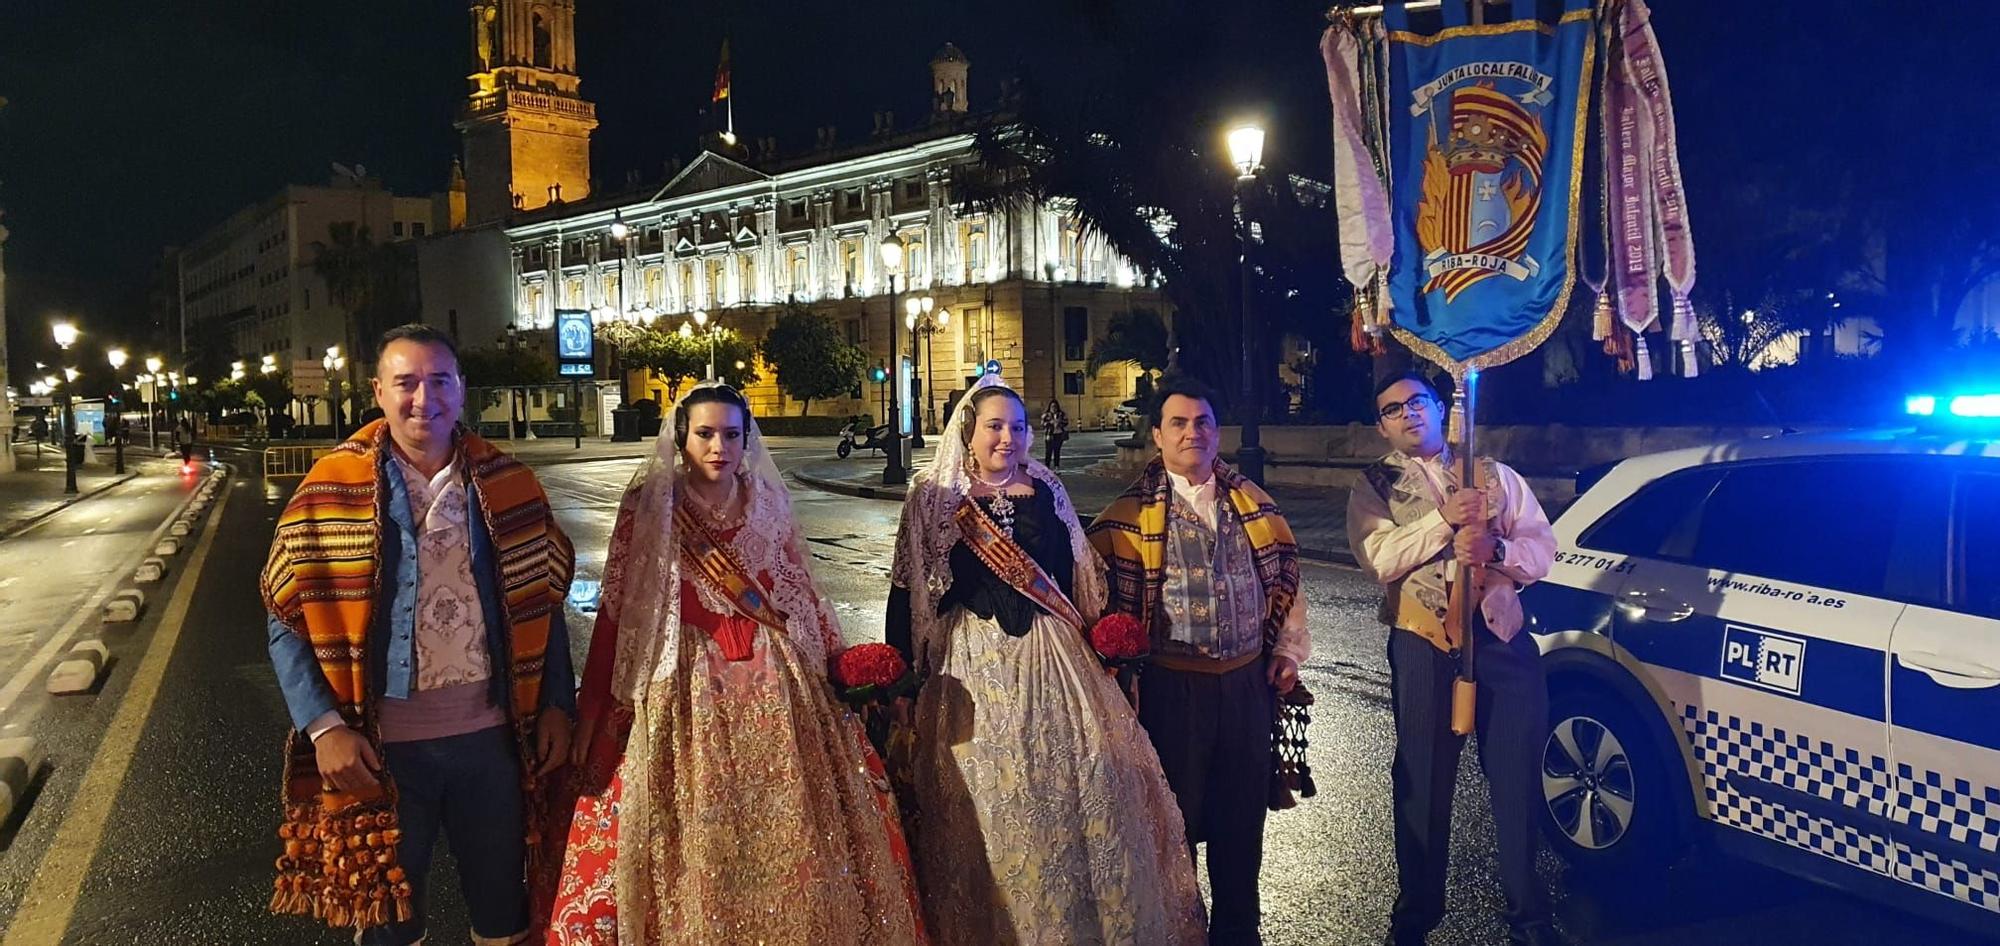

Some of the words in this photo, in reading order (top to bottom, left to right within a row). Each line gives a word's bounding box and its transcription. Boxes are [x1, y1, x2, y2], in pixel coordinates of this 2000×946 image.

[1437, 68, 1465, 90] JUNTA
[1467, 63, 1504, 76] LOCAL
[1624, 195, 1642, 240] Infantil
[1441, 255, 1507, 272] RIBA-ROJA
[1628, 245, 1643, 272] 2019
[1566, 554, 1595, 567] 277
[1594, 558, 1614, 570] 01
[1616, 562, 1637, 574] 51
[1707, 577, 1846, 609] www.riba-roa.es
[1727, 641, 1753, 667] PL
[1765, 650, 1796, 676] RT
